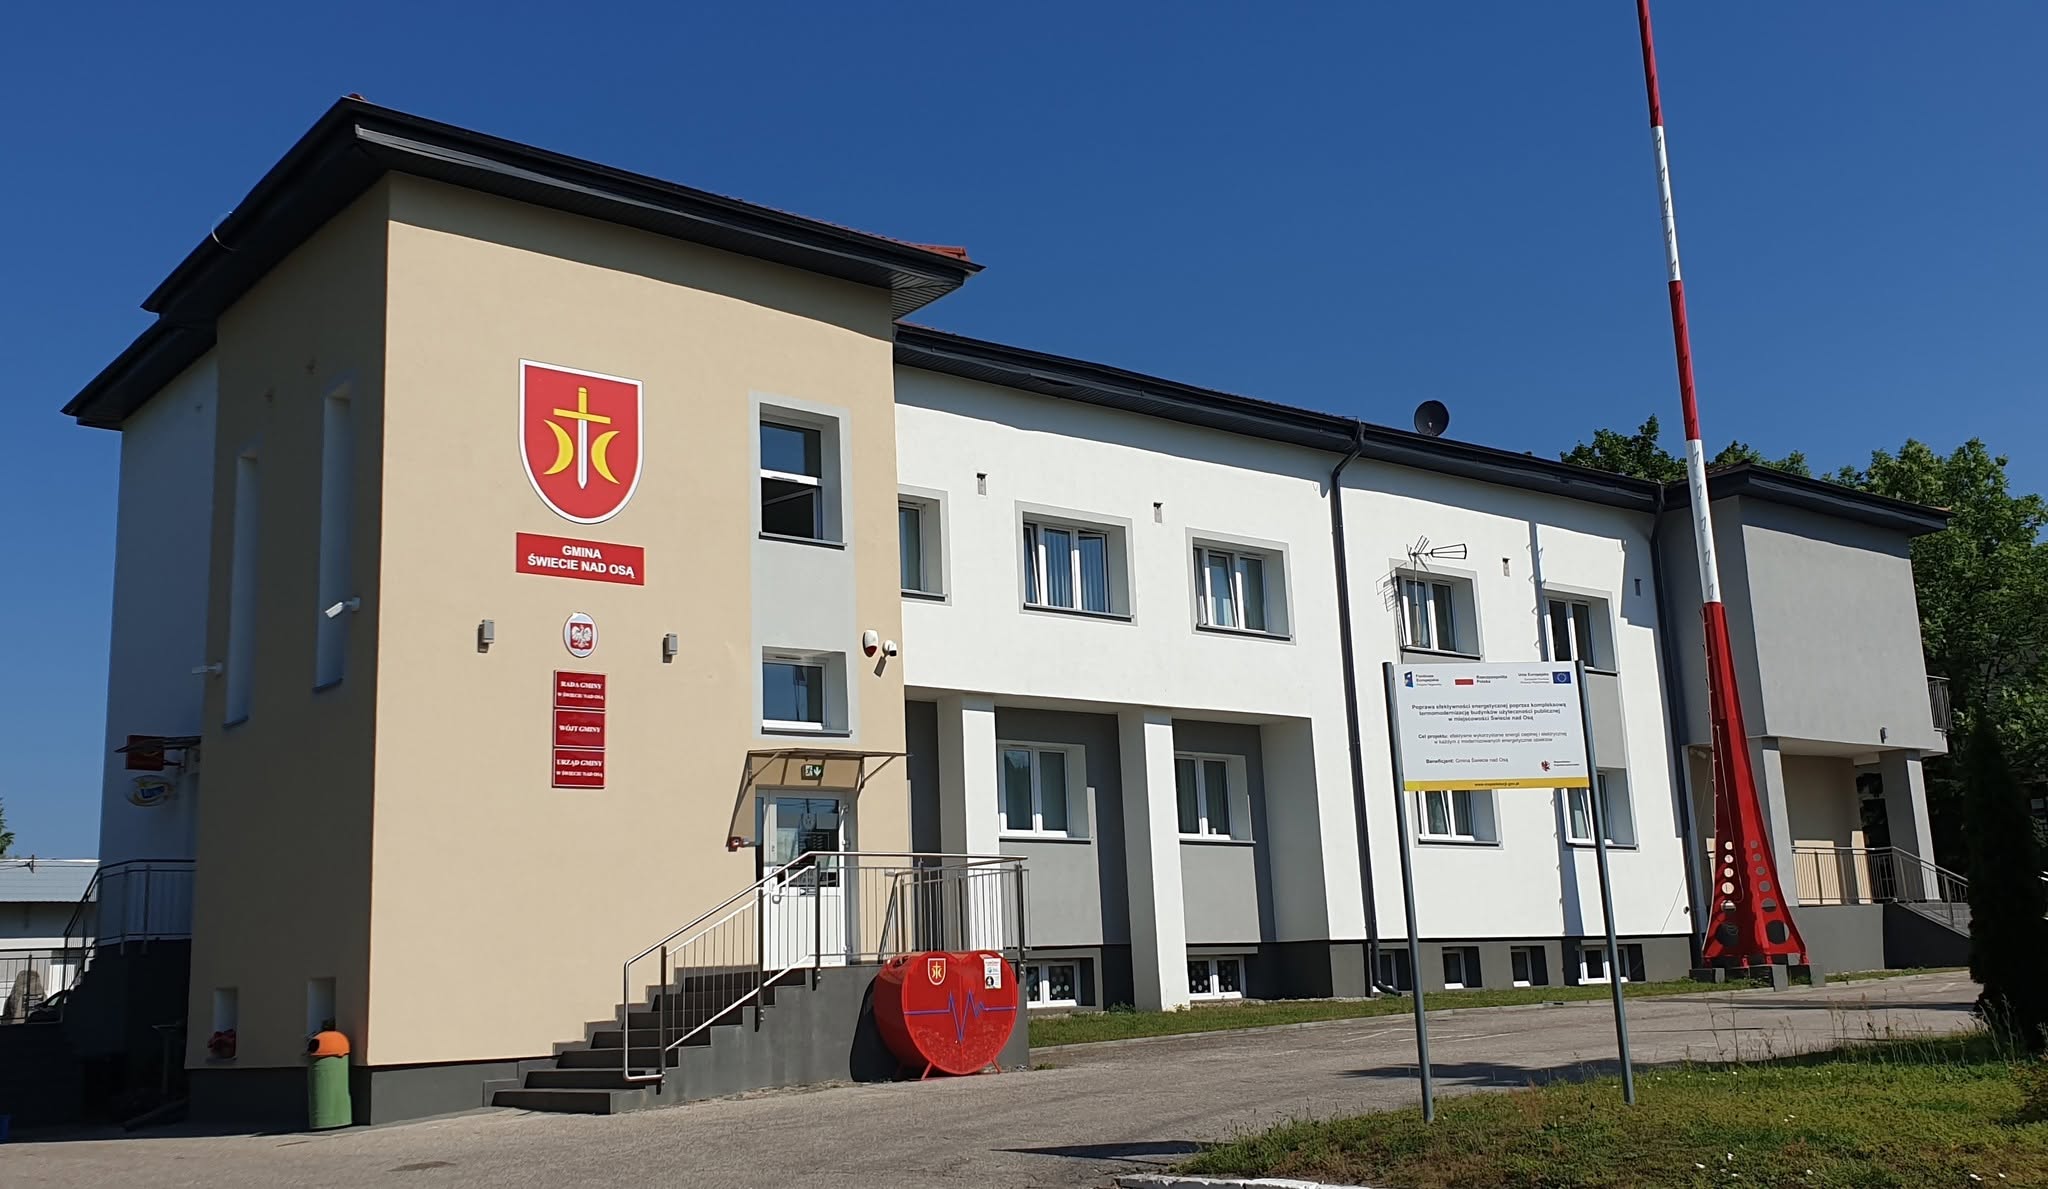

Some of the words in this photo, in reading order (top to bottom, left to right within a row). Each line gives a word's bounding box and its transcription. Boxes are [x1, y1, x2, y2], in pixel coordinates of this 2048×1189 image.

[562, 545, 602, 559] GMINA
[527, 553, 579, 570] ŚWIECIE
[581, 561, 607, 573] NAD
[609, 564, 636, 579] OSĄ
[580, 682, 603, 690] GMINY
[559, 724, 579, 732] WÓJT
[557, 759, 580, 767] URZĄD
